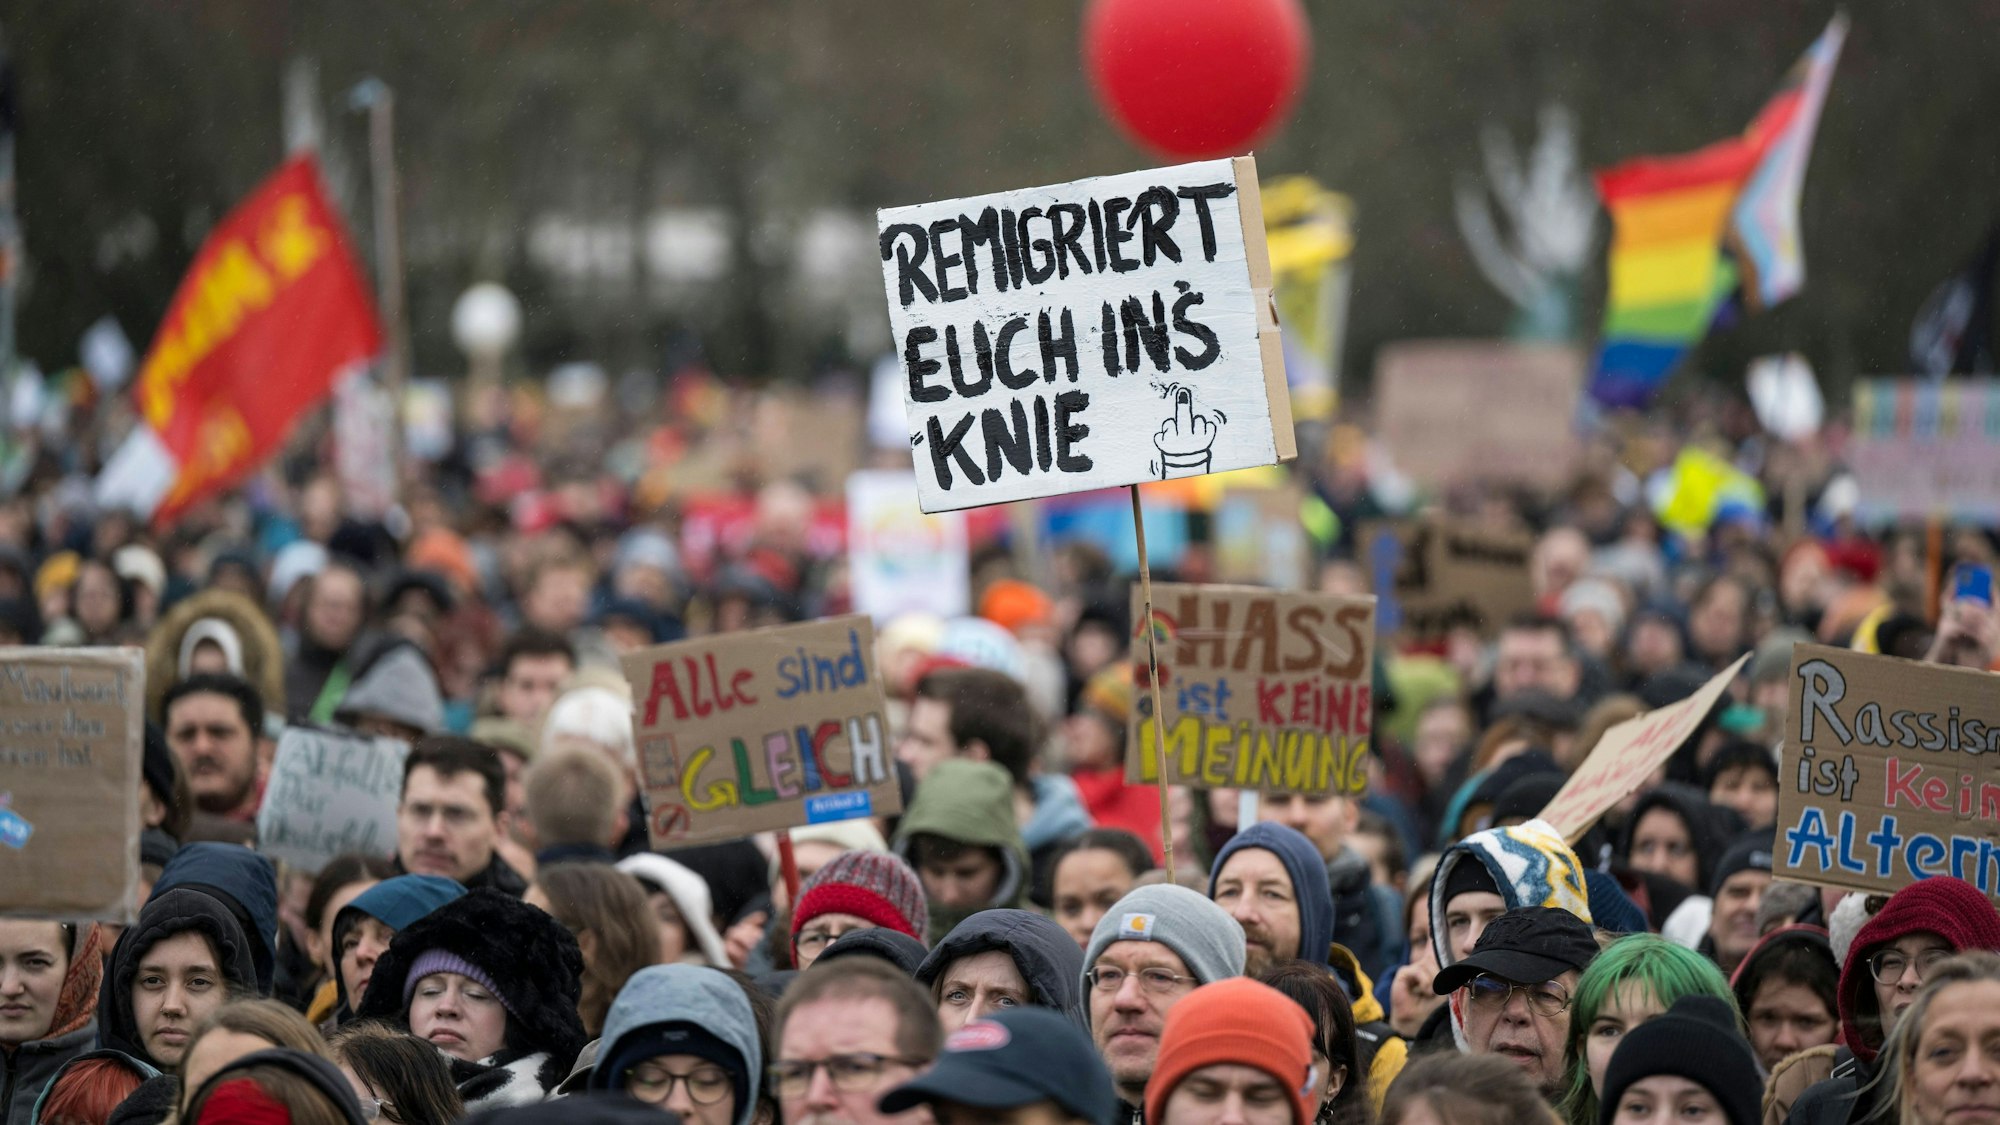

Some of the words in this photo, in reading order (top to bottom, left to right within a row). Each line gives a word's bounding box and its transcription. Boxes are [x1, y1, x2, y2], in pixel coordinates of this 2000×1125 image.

[879, 182, 1237, 307] REMIGRIERT
[905, 306, 1080, 403] EUCH
[927, 390, 1094, 491] KNIE
[643, 652, 759, 728] Alle
[775, 629, 867, 698] sind
[1175, 595, 1371, 680] HASS
[1174, 676, 1232, 722] ist
[681, 712, 888, 812] GLEICH
[1797, 746, 1860, 803] ist
